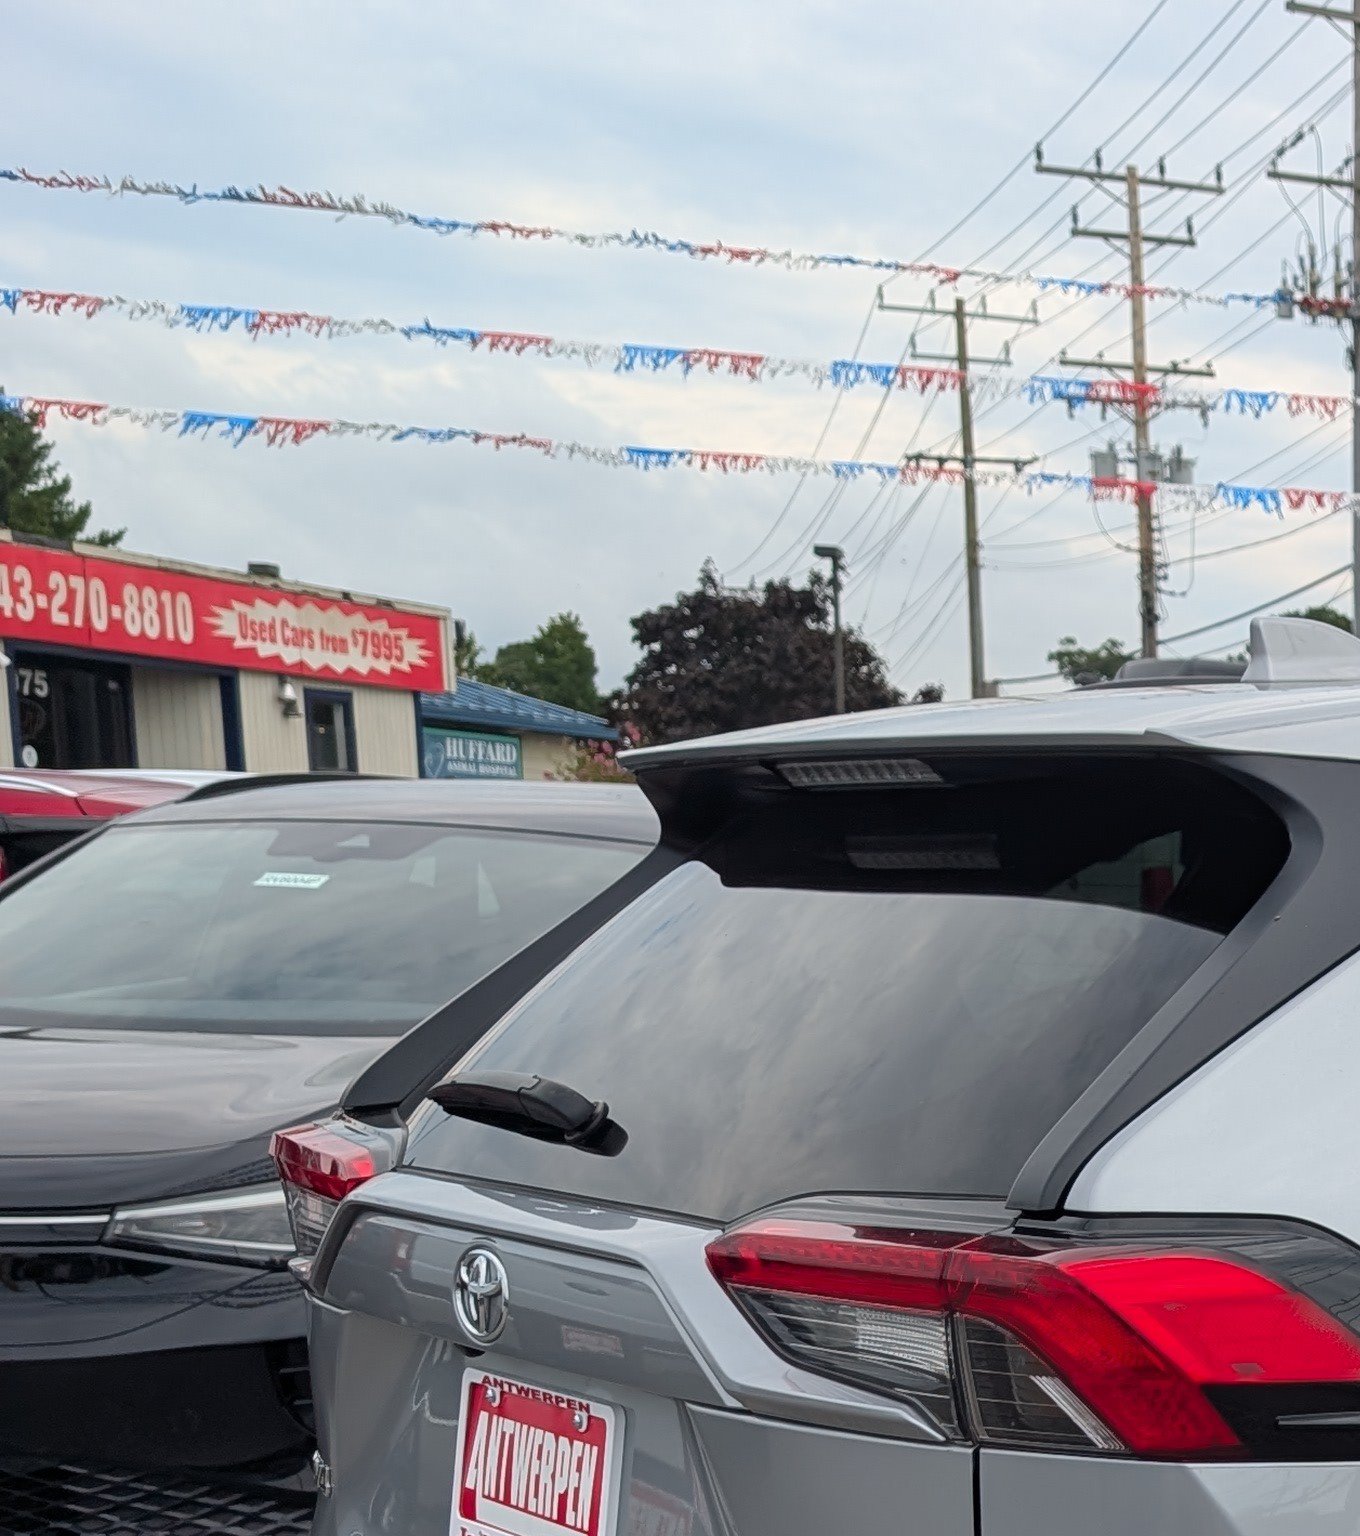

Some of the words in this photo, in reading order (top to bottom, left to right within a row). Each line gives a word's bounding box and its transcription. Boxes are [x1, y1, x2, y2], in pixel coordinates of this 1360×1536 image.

[237, 611, 278, 644] Used
[280, 617, 315, 650] Cars
[320, 627, 350, 655] from
[352, 627, 405, 662] $7995
[446, 736, 517, 763] HUFFARD
[481, 1375, 591, 1414] ANTWERPEN
[465, 1410, 599, 1532] ANTWERPEN
